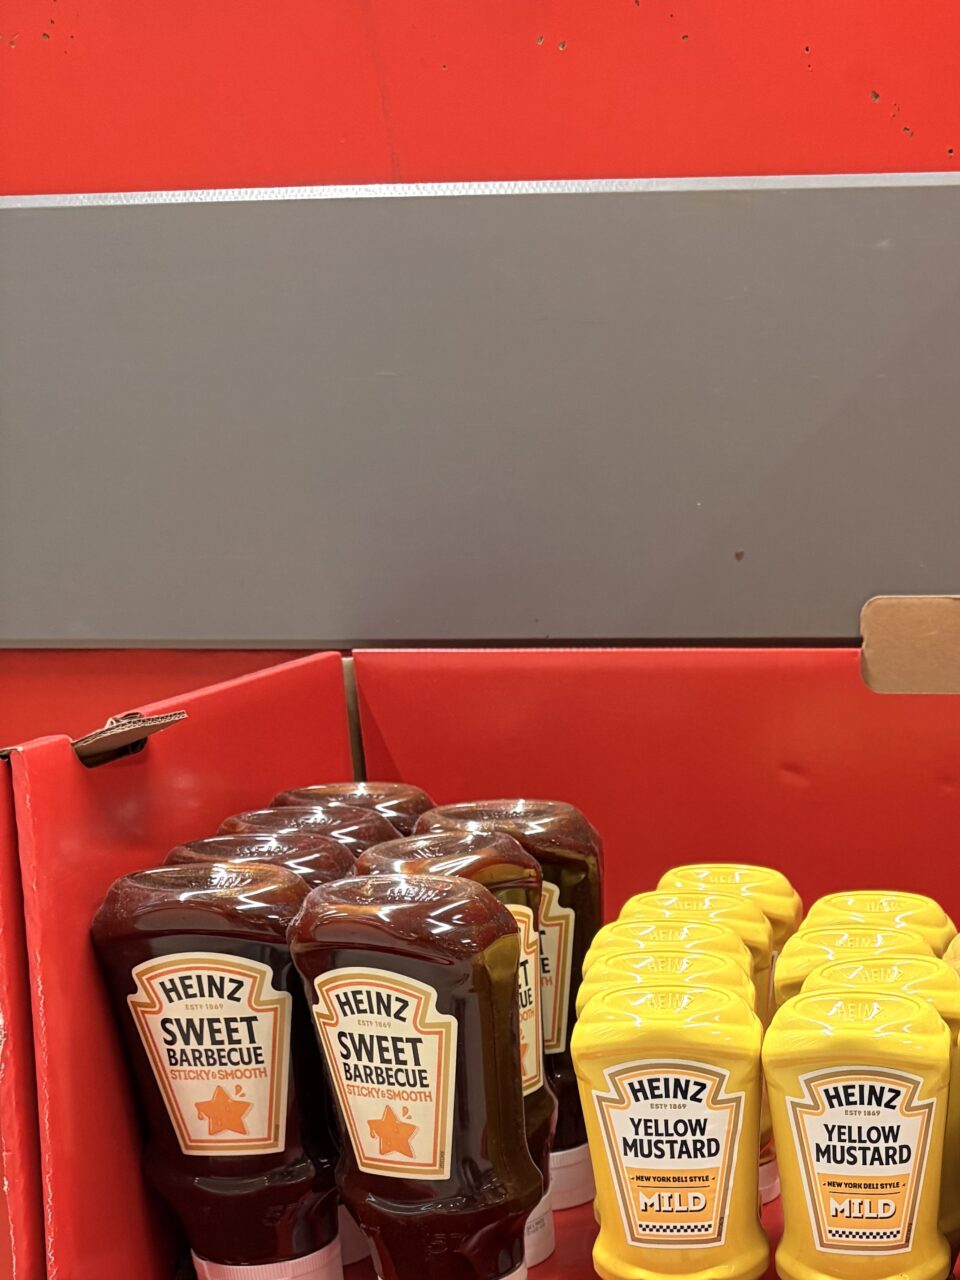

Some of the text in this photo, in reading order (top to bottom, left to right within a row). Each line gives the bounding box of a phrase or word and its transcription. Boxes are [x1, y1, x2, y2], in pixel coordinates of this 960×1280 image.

[160, 975, 244, 1004] HEINZ
[335, 990, 409, 1022] HEINZ
[161, 1016, 258, 1046] SWEET
[167, 1047, 264, 1067] BARBECUE
[338, 1031, 423, 1066] SWEET
[343, 1064, 429, 1088] BARBECUE
[628, 1078, 707, 1104] HEINZ
[824, 1084, 901, 1110] HEINZ
[670, 1102, 687, 1110] 1869
[630, 1118, 707, 1137] YELLOW
[823, 1124, 900, 1144] YELLOW
[623, 1138, 720, 1159] MUSTARD
[816, 1143, 912, 1166] MUSTARD
[826, 1181, 900, 1189] NEW YORK DELI STYLE
[640, 1192, 706, 1213] MILD
[830, 1198, 896, 1220] MILD
